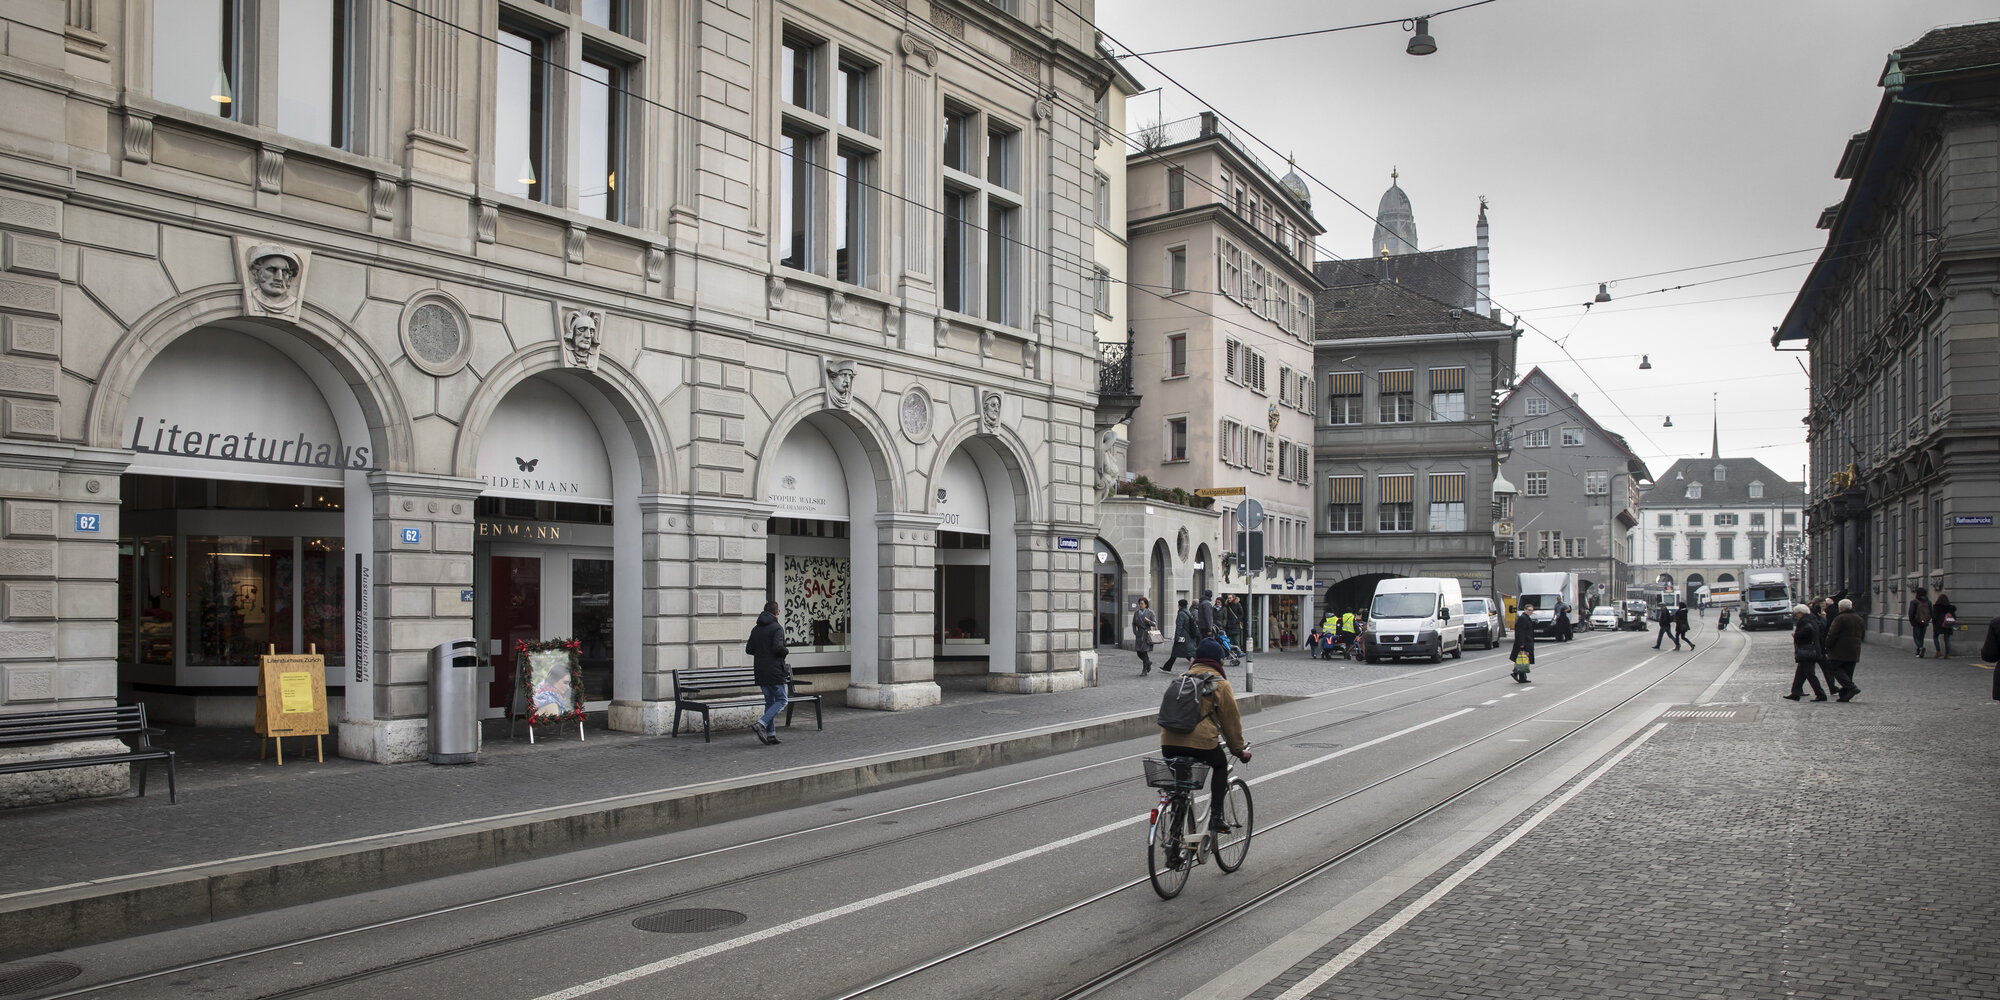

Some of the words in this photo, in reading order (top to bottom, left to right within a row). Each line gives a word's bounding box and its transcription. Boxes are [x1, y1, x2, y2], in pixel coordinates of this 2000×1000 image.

[131, 416, 369, 469] Literaturhaus
[80, 516, 96, 530] 62
[406, 530, 417, 541] 62
[813, 566, 831, 580] SALE
[804, 579, 836, 598] SALE
[794, 594, 817, 615] SALE
[821, 599, 837, 615] SALE
